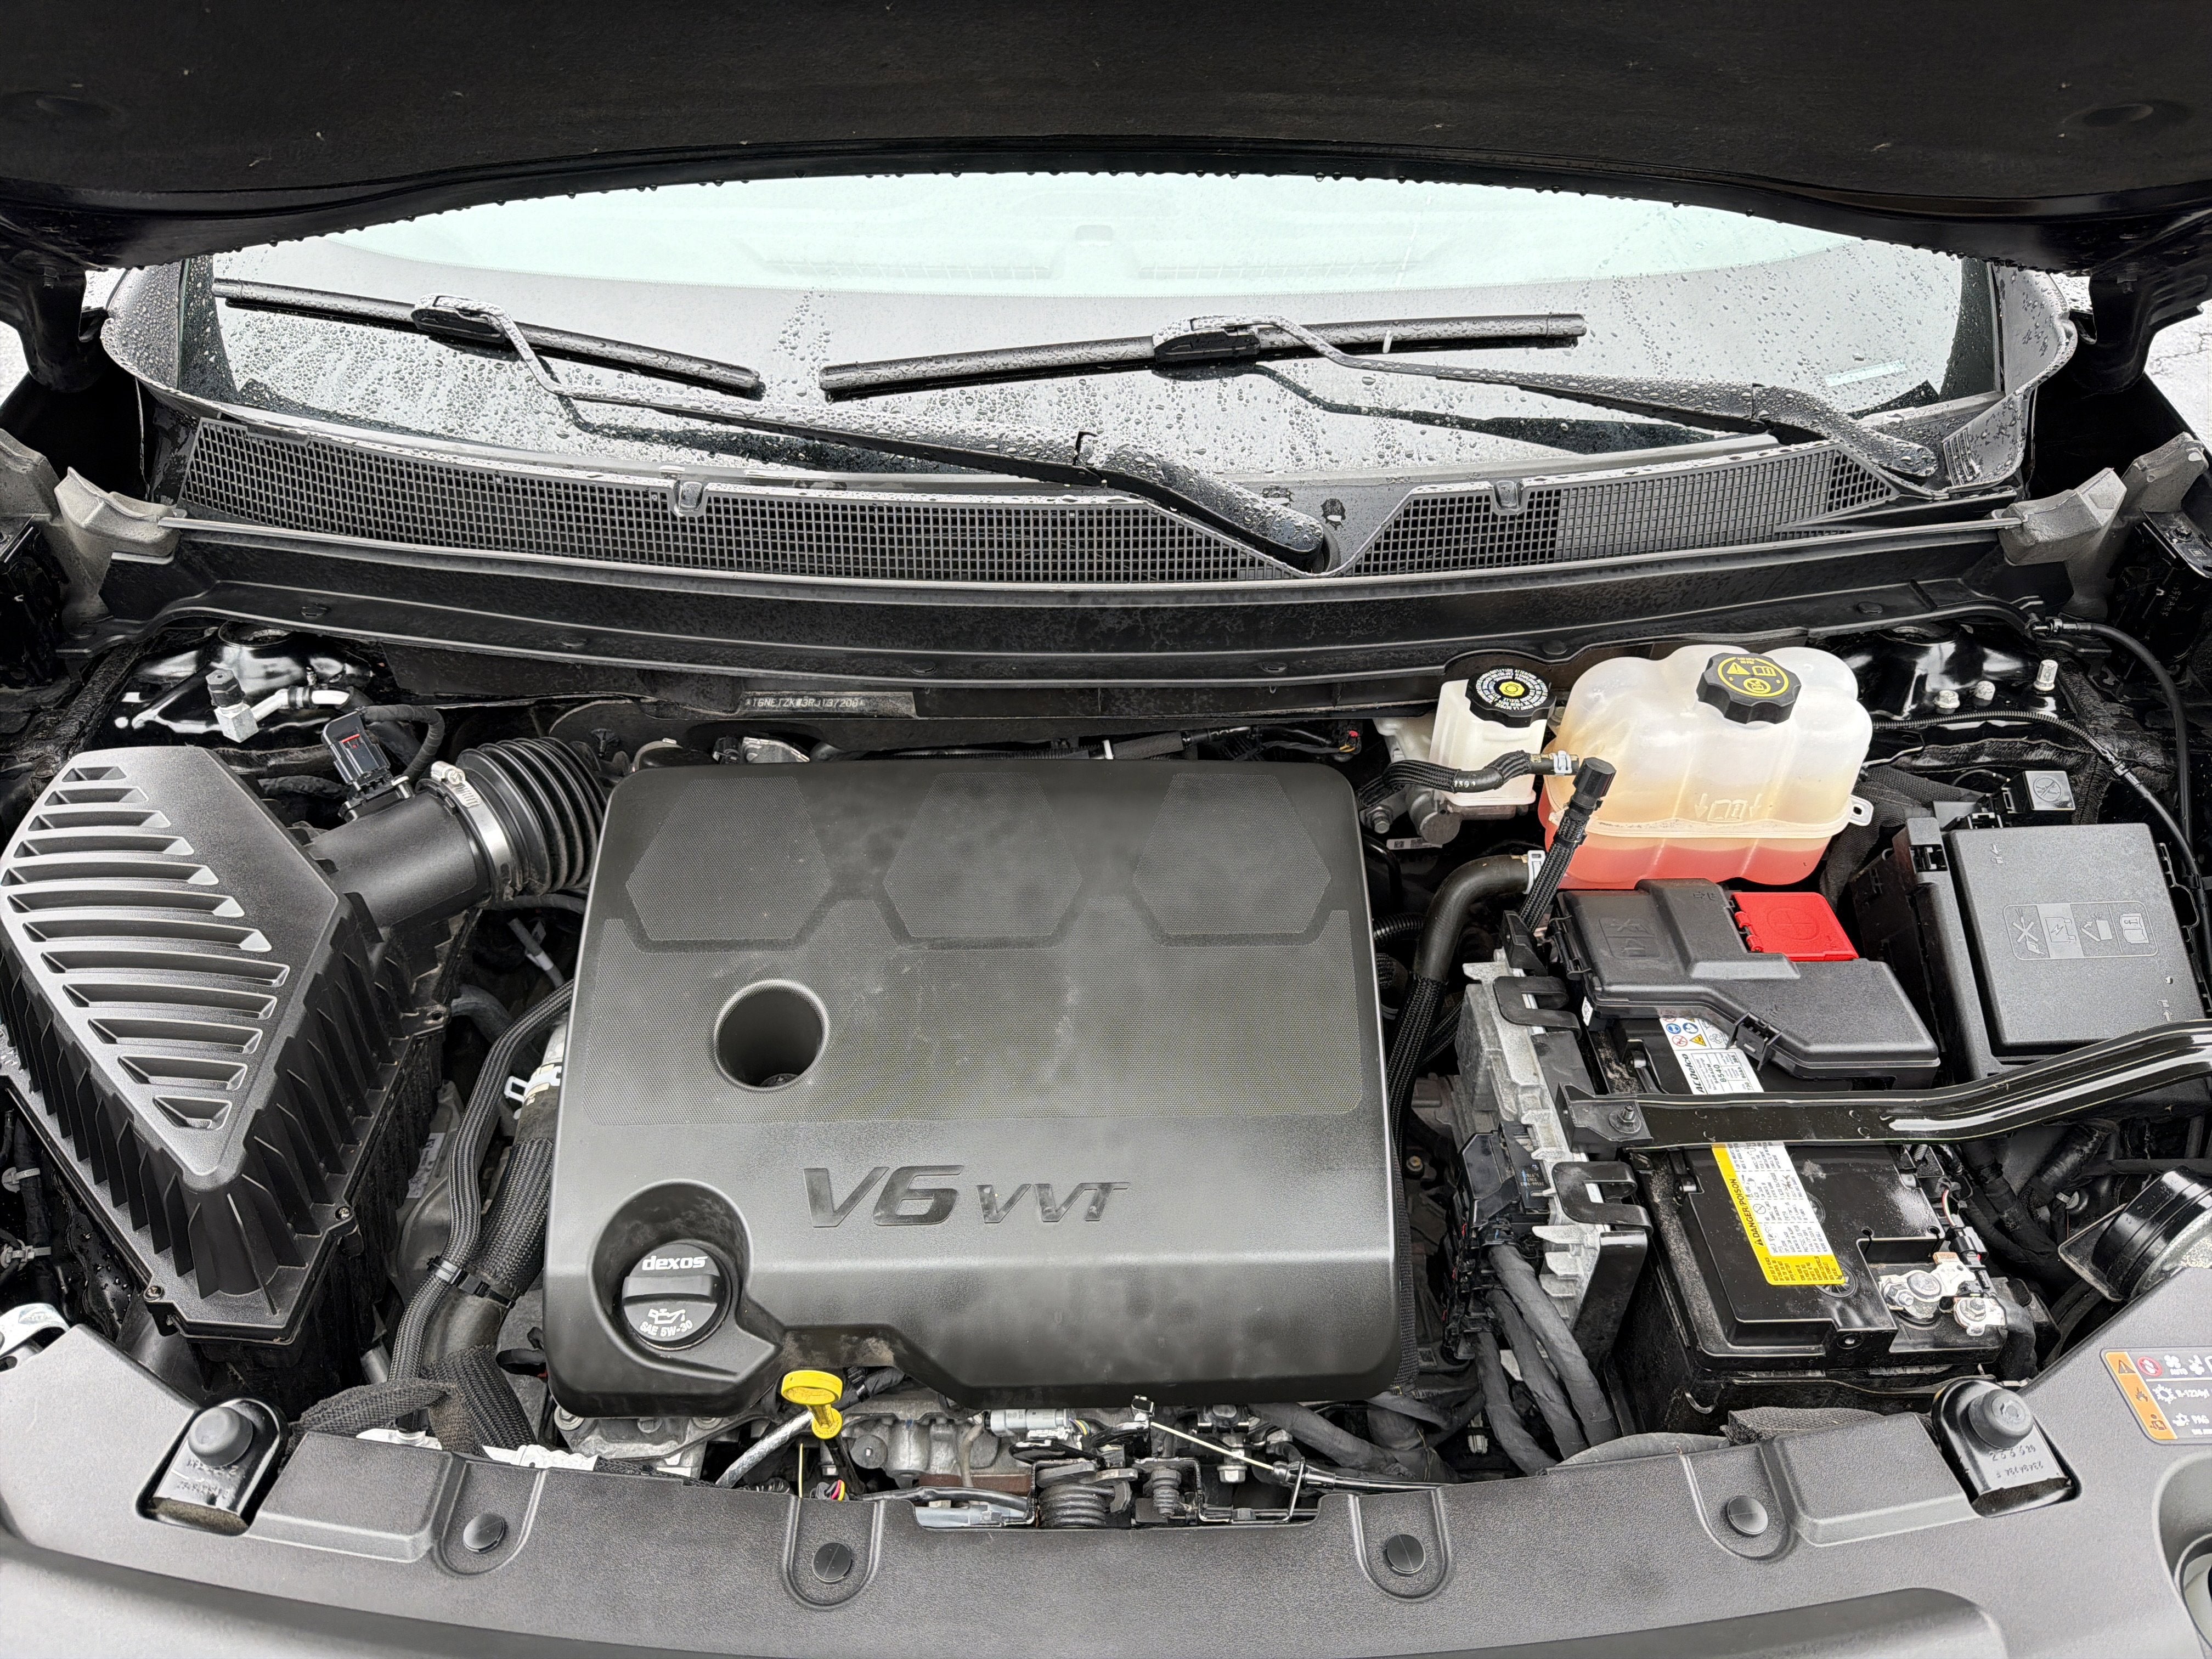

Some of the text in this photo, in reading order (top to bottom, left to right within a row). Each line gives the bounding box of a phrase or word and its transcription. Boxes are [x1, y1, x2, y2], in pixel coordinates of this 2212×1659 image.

[1681, 1053, 1705, 1093] ACDelco
[803, 1165, 1131, 1227] V6 VVT
[1730, 1178, 1760, 1238] DANGER/POISON
[641, 1255, 708, 1271] dexos
[640, 1319, 693, 1337] SAE 5W-30
